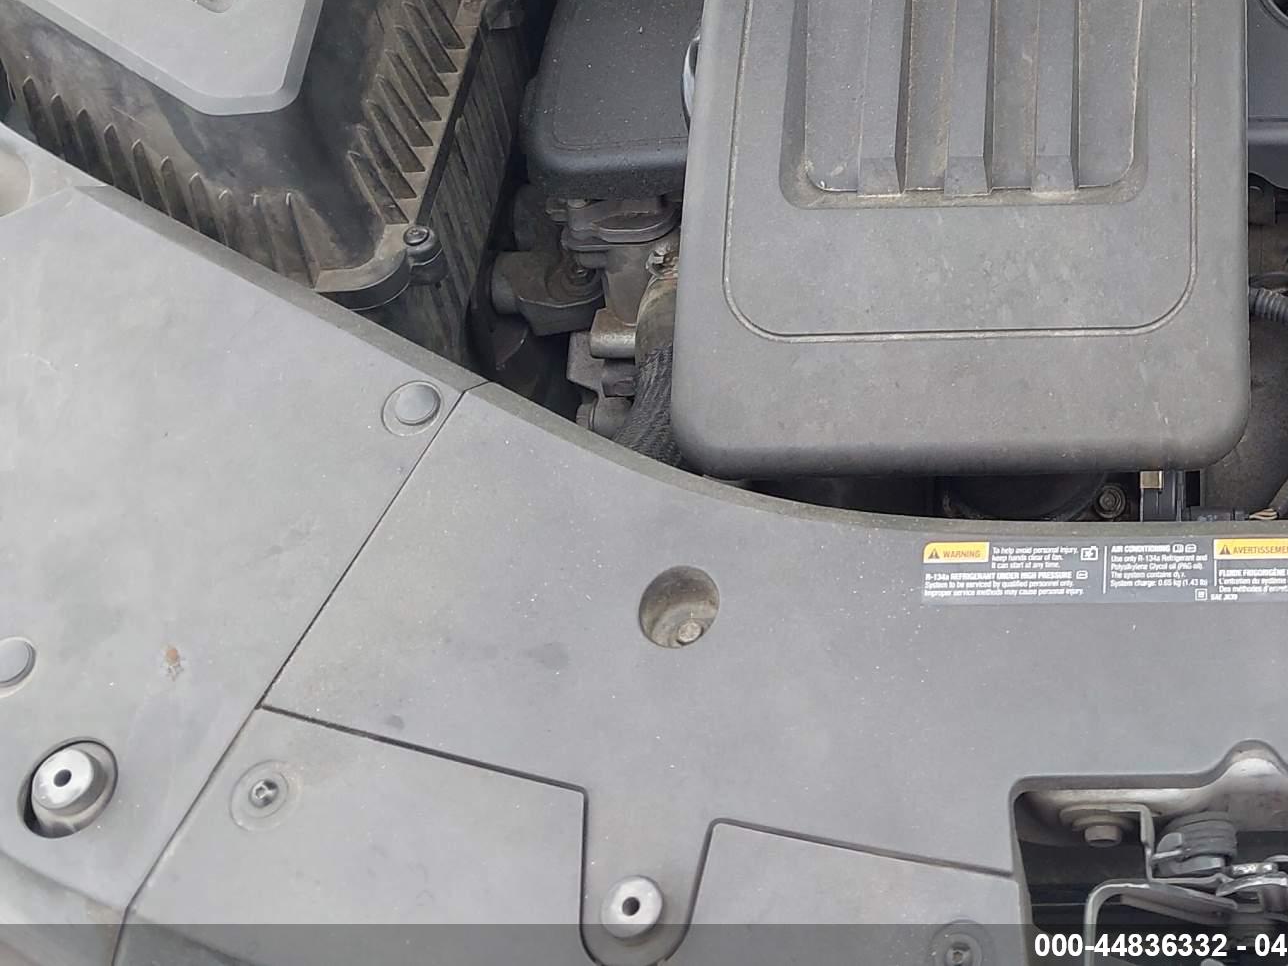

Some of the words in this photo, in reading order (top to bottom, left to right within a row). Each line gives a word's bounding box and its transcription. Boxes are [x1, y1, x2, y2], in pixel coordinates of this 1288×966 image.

[943, 550, 981, 558] WARNING
[993, 546, 1000, 554] To
[1001, 546, 1014, 554] help
[1016, 546, 1032, 554] avoid
[1033, 546, 1059, 554] personal
[925, 581, 948, 589] System
[956, 581, 965, 589] be
[1173, 579, 1182, 587] kg
